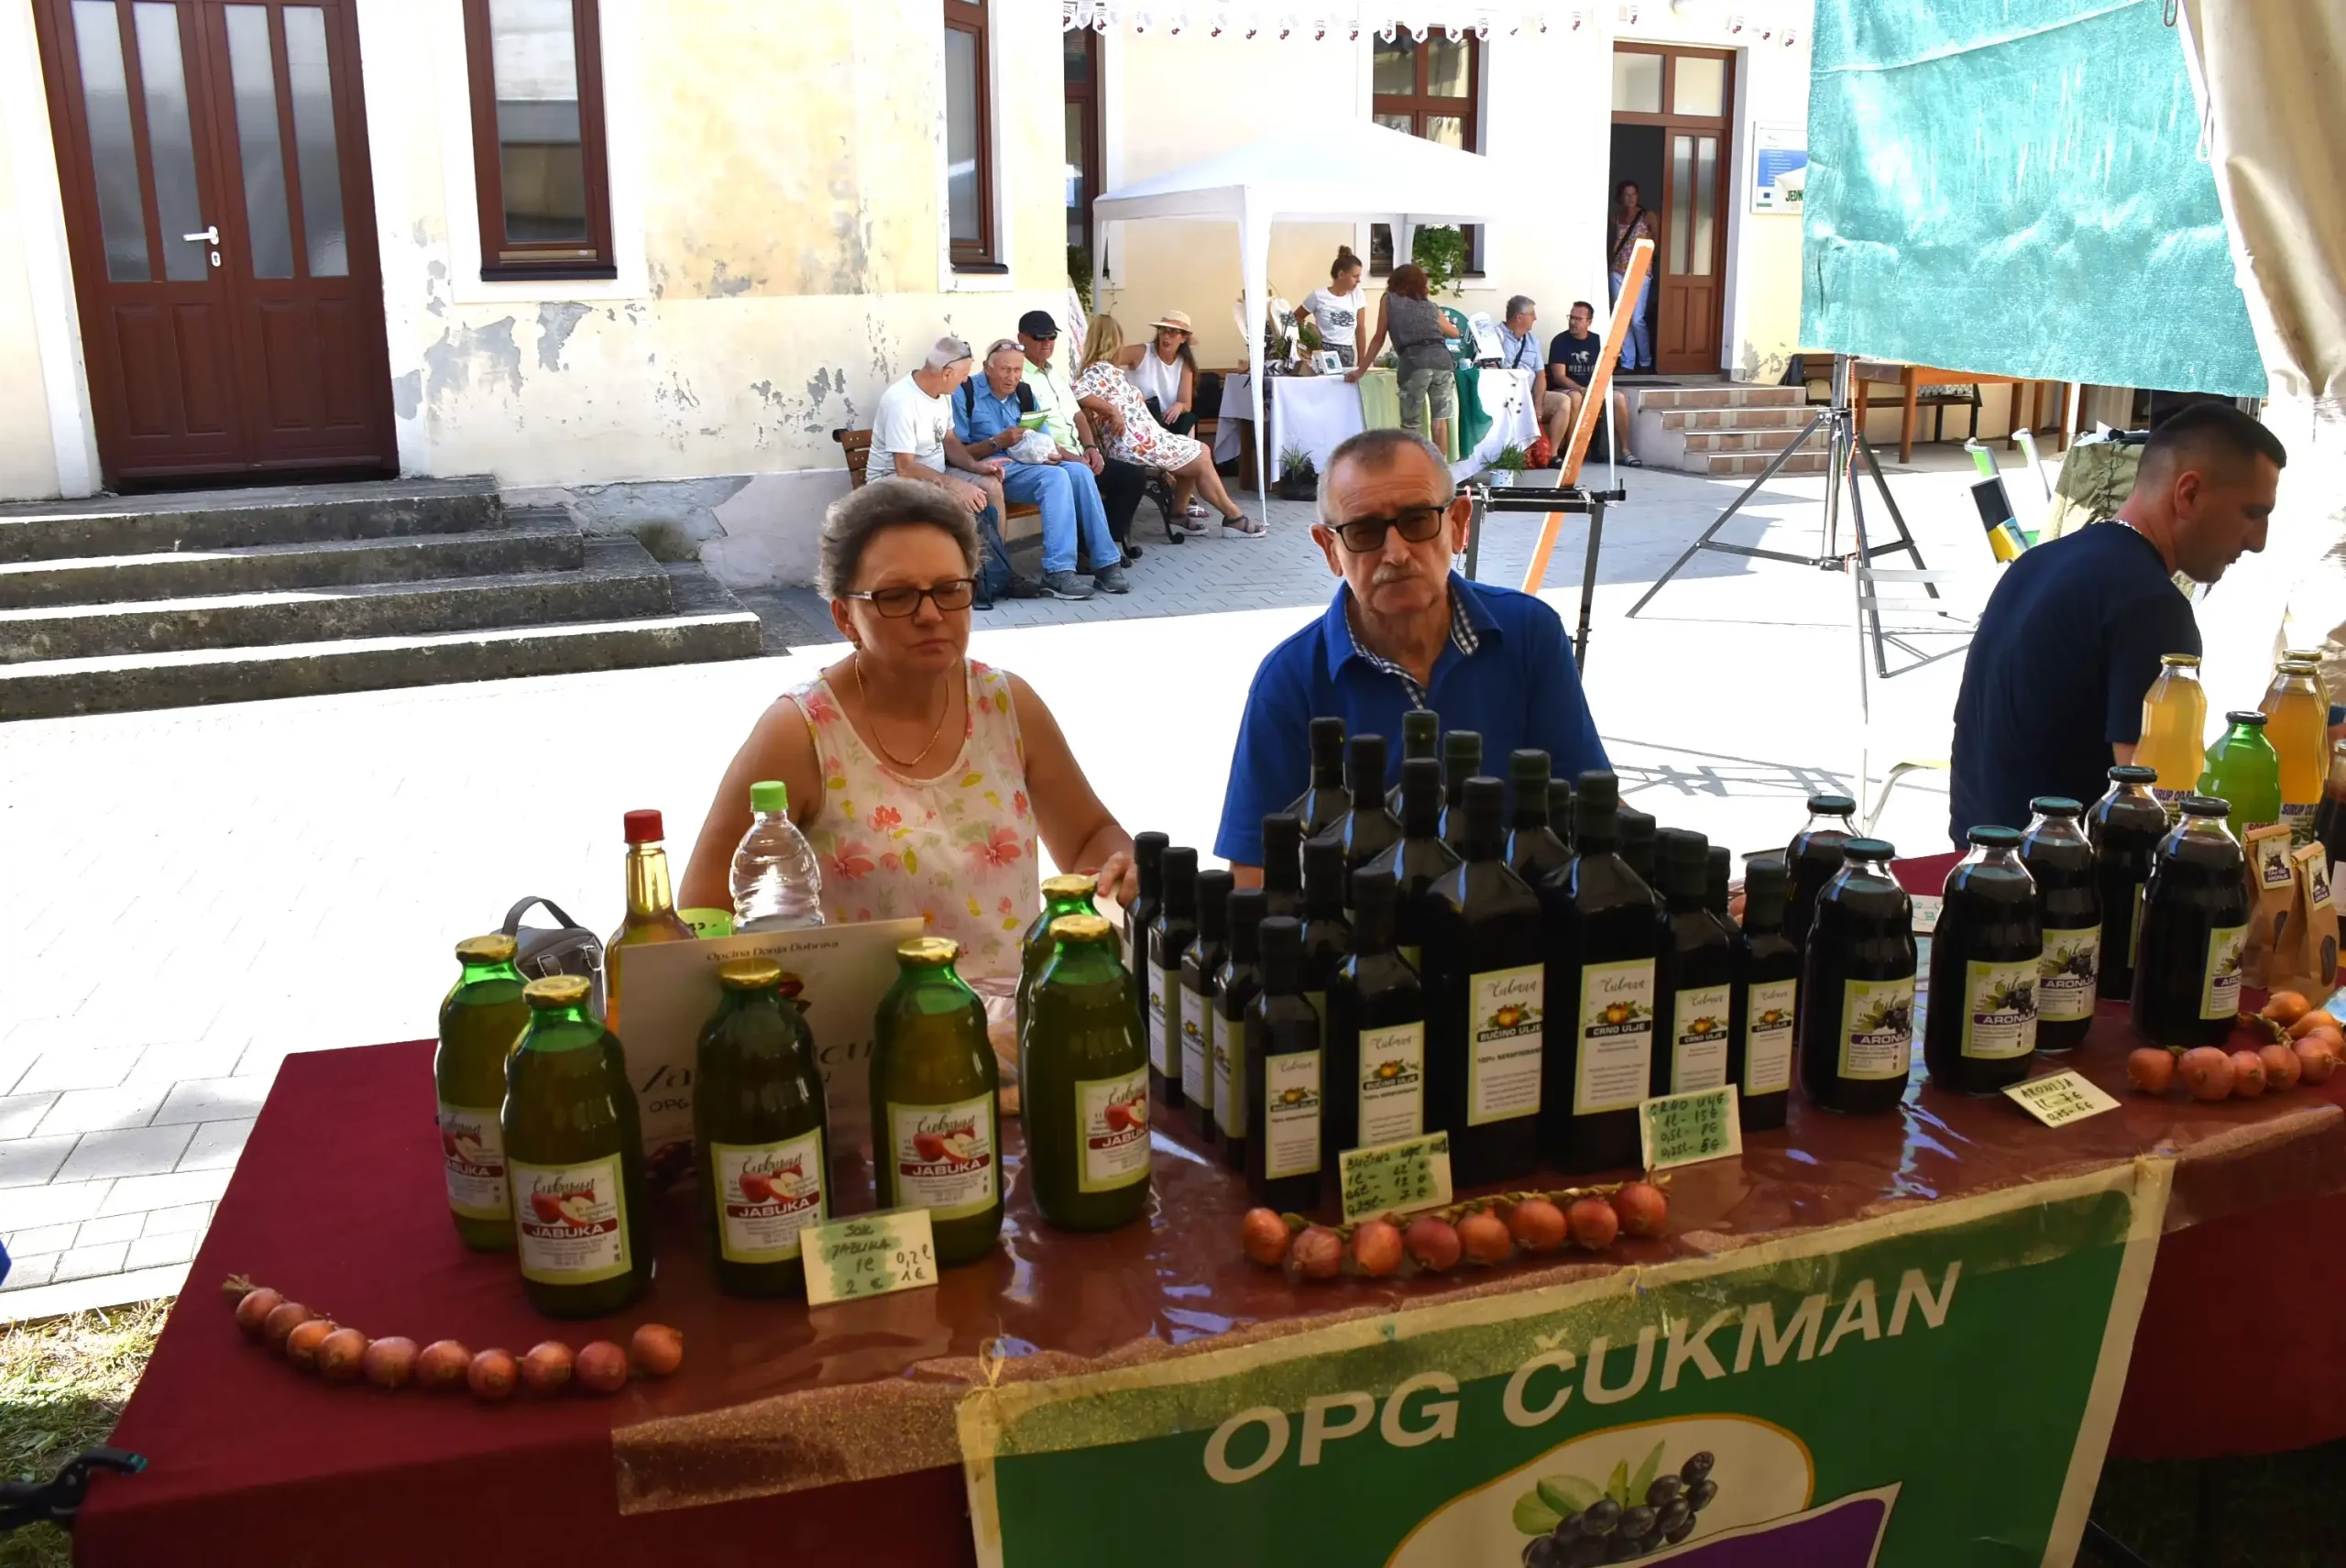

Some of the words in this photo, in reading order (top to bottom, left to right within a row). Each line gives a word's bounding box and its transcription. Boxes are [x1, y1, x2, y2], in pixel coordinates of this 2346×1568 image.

[1593, 1025, 1620, 1036] CRNO
[1621, 1022, 1646, 1034] ULJE
[2021, 1077, 2074, 1099] ARONIJA
[1650, 1100, 1689, 1116] CRNO
[912, 1159, 981, 1176] JABUKA
[739, 1198, 811, 1217] JABUKA
[532, 1223, 604, 1239] JABUKA
[844, 1223, 874, 1238] SOK
[831, 1237, 892, 1260] JABUKA
[1202, 1369, 1462, 1486] OPG
[1500, 1260, 1962, 1429] ČUKMAN
